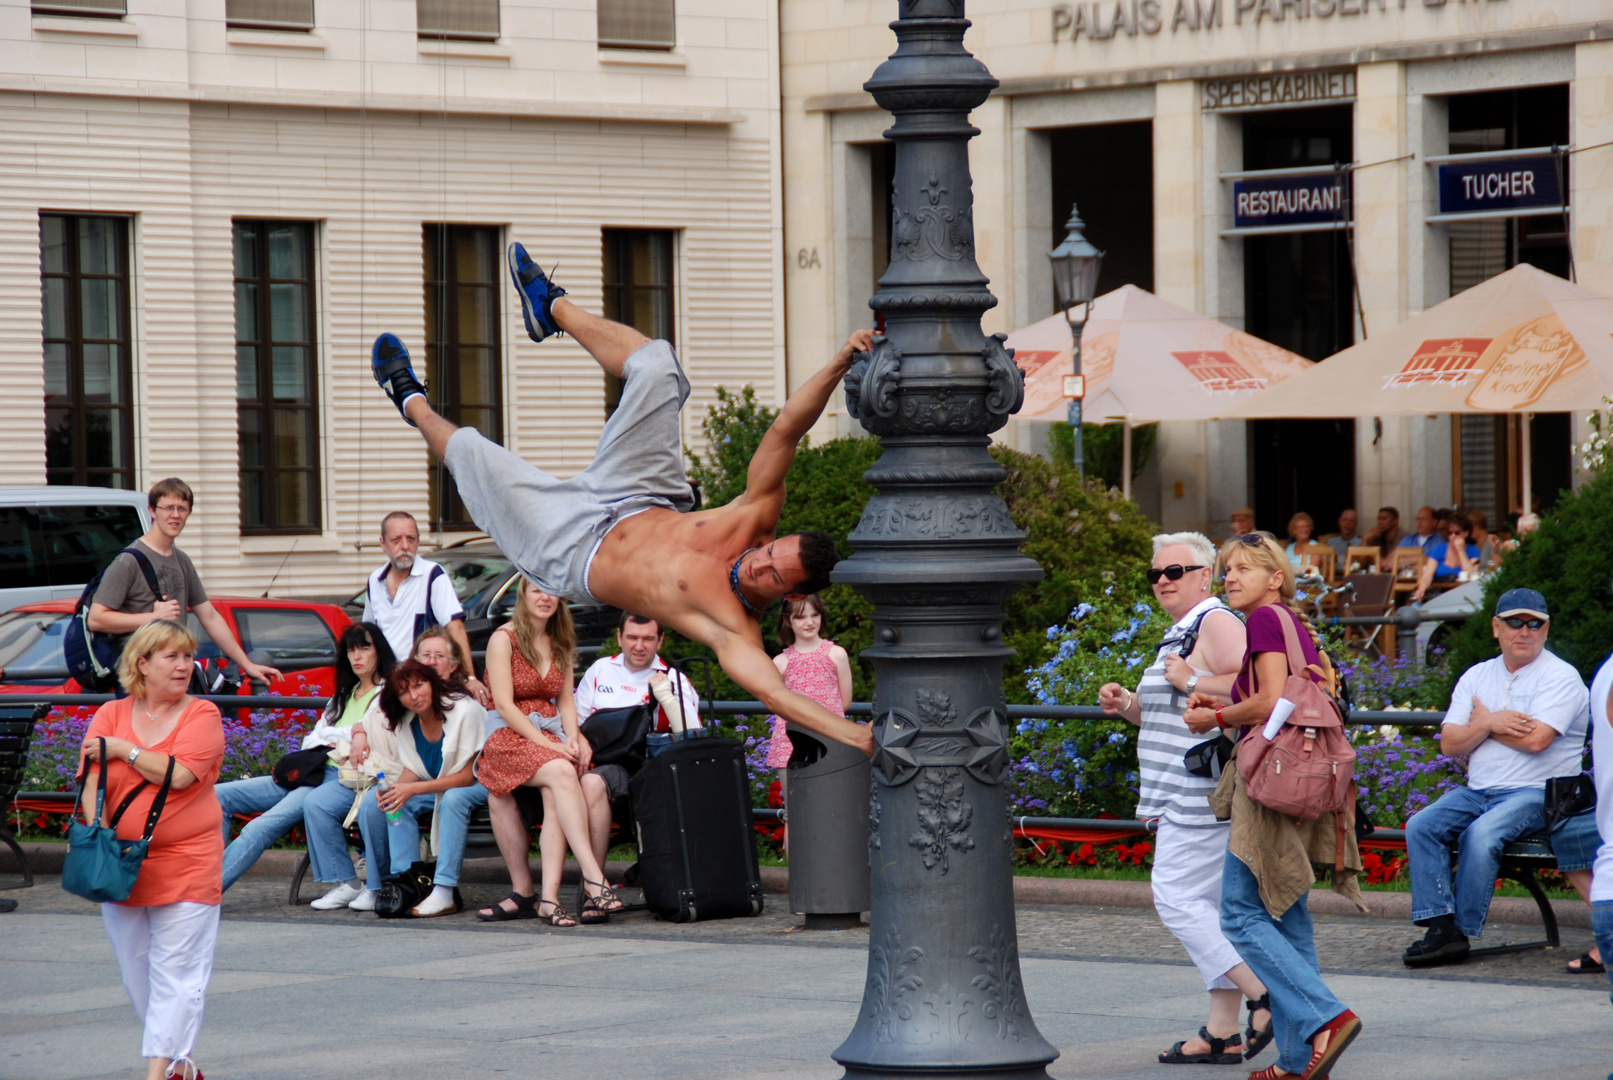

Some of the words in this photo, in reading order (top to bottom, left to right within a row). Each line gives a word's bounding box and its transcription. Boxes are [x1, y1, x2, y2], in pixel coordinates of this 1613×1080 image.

[1052, 0, 1162, 44] PALAIS
[1171, 0, 1223, 33] AM
[1462, 170, 1535, 199] TUCHER
[1238, 186, 1341, 216] RESTAURANT
[798, 247, 822, 270] 6A
[1492, 356, 1560, 378] Berliner
[1489, 379, 1536, 394] Kindl
